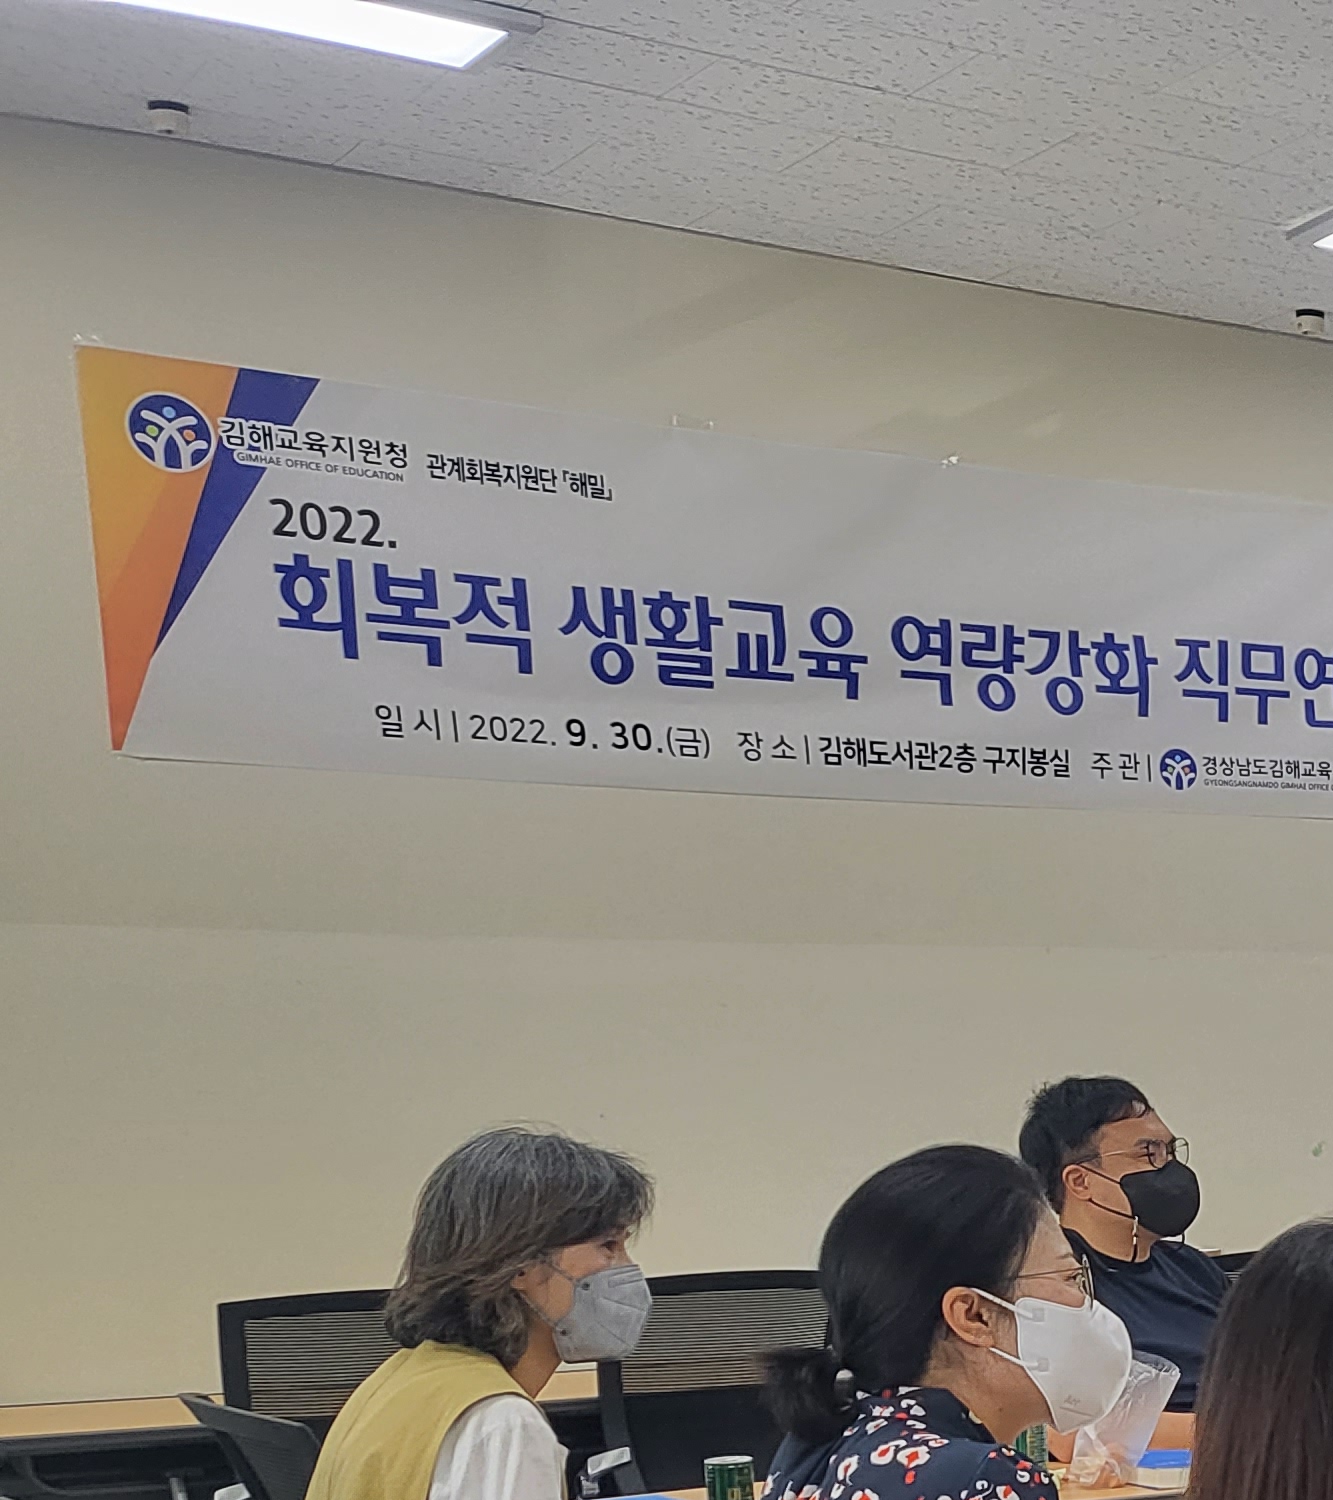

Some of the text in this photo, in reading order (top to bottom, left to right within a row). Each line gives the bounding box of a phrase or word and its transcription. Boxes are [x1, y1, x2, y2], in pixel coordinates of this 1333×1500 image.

[220, 420, 408, 469] 김해교육지원청
[236, 451, 404, 483] GIMHAE OFFICE OF EDUCATION
[427, 454, 557, 493] 관계회복지원단
[270, 499, 398, 549] 2022.
[274, 554, 534, 675] 회복적
[559, 584, 868, 700] 생활교육
[890, 615, 1158, 718] 역량강화
[818, 735, 978, 774] 김해도서관2층
[982, 745, 1071, 779] 구지봉실
[1203, 778, 1280, 790] GYEONGSANGNAMDO
[1281, 782, 1308, 791] GIMHAE
[1308, 783, 1330, 792] OFFICE
